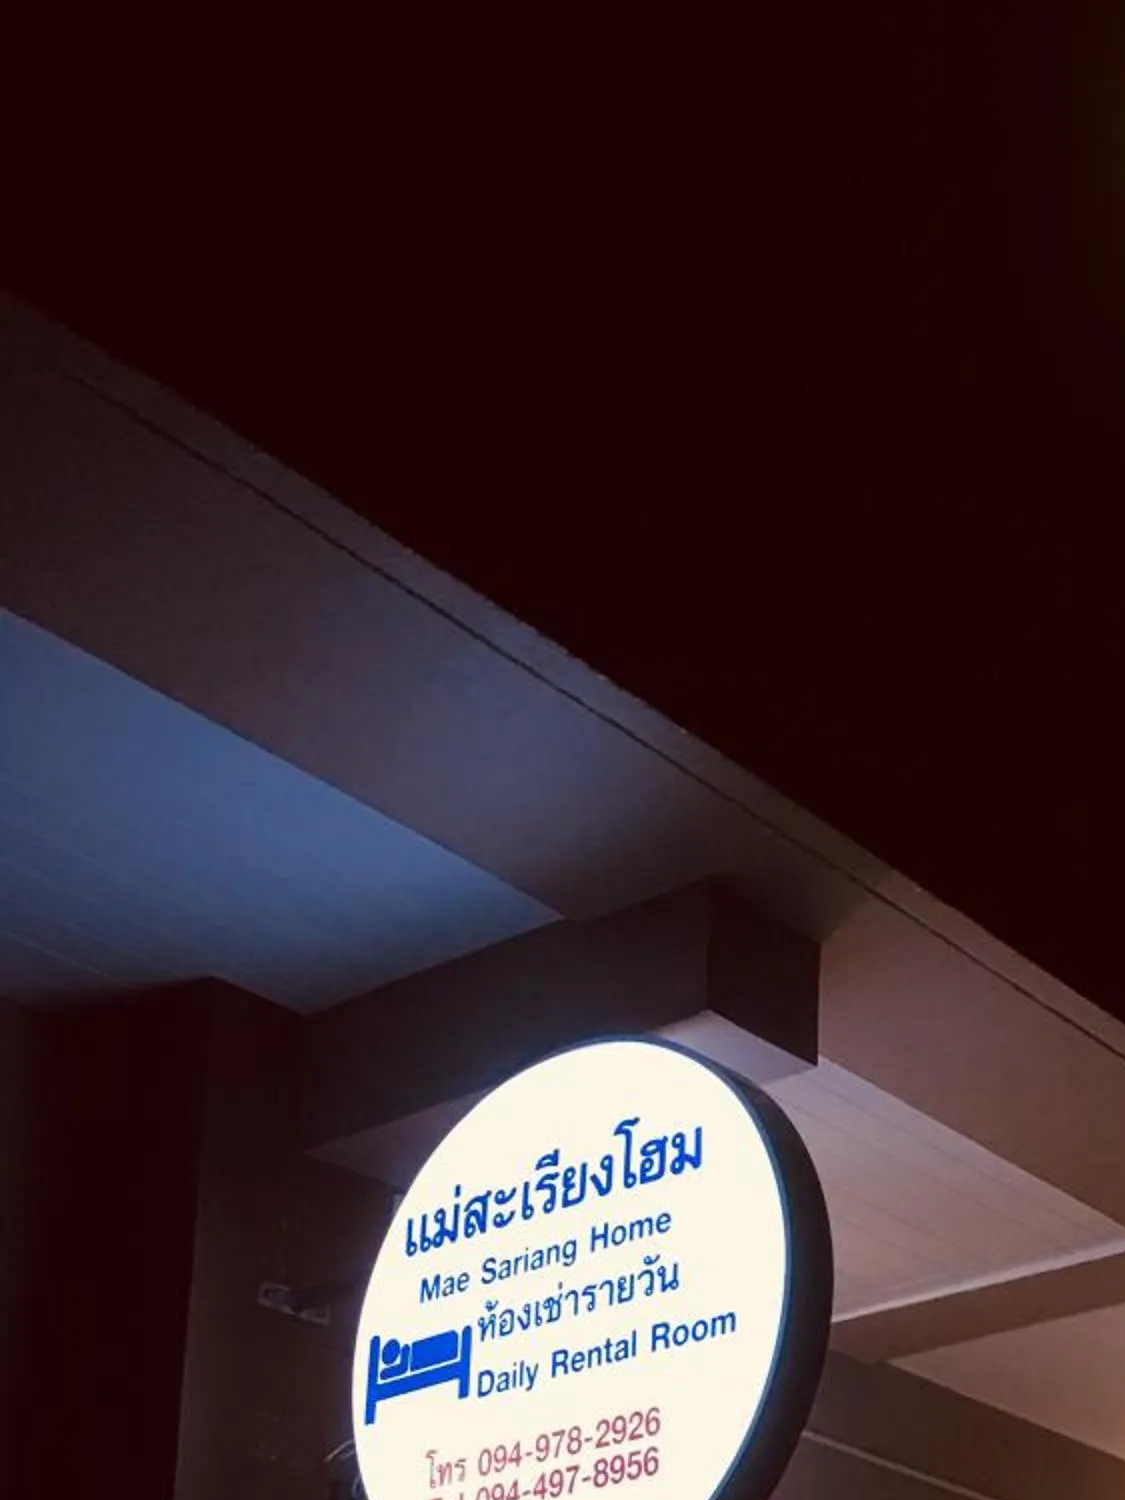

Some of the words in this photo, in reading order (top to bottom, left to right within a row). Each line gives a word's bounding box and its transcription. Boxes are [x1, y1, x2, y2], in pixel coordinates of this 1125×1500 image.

[405, 1117, 702, 1257] แม่สะเรียงโฮม
[420, 1272, 470, 1303] Mae
[481, 1239, 577, 1284] Sariang
[590, 1213, 672, 1253] Home
[478, 1254, 679, 1342] ห้องเช่ารายวัน
[477, 1360, 539, 1398] Daily
[552, 1330, 637, 1378] Rental
[651, 1312, 737, 1352] Room
[426, 1450, 467, 1488] โทร
[478, 1407, 661, 1476] 094-978-2926
